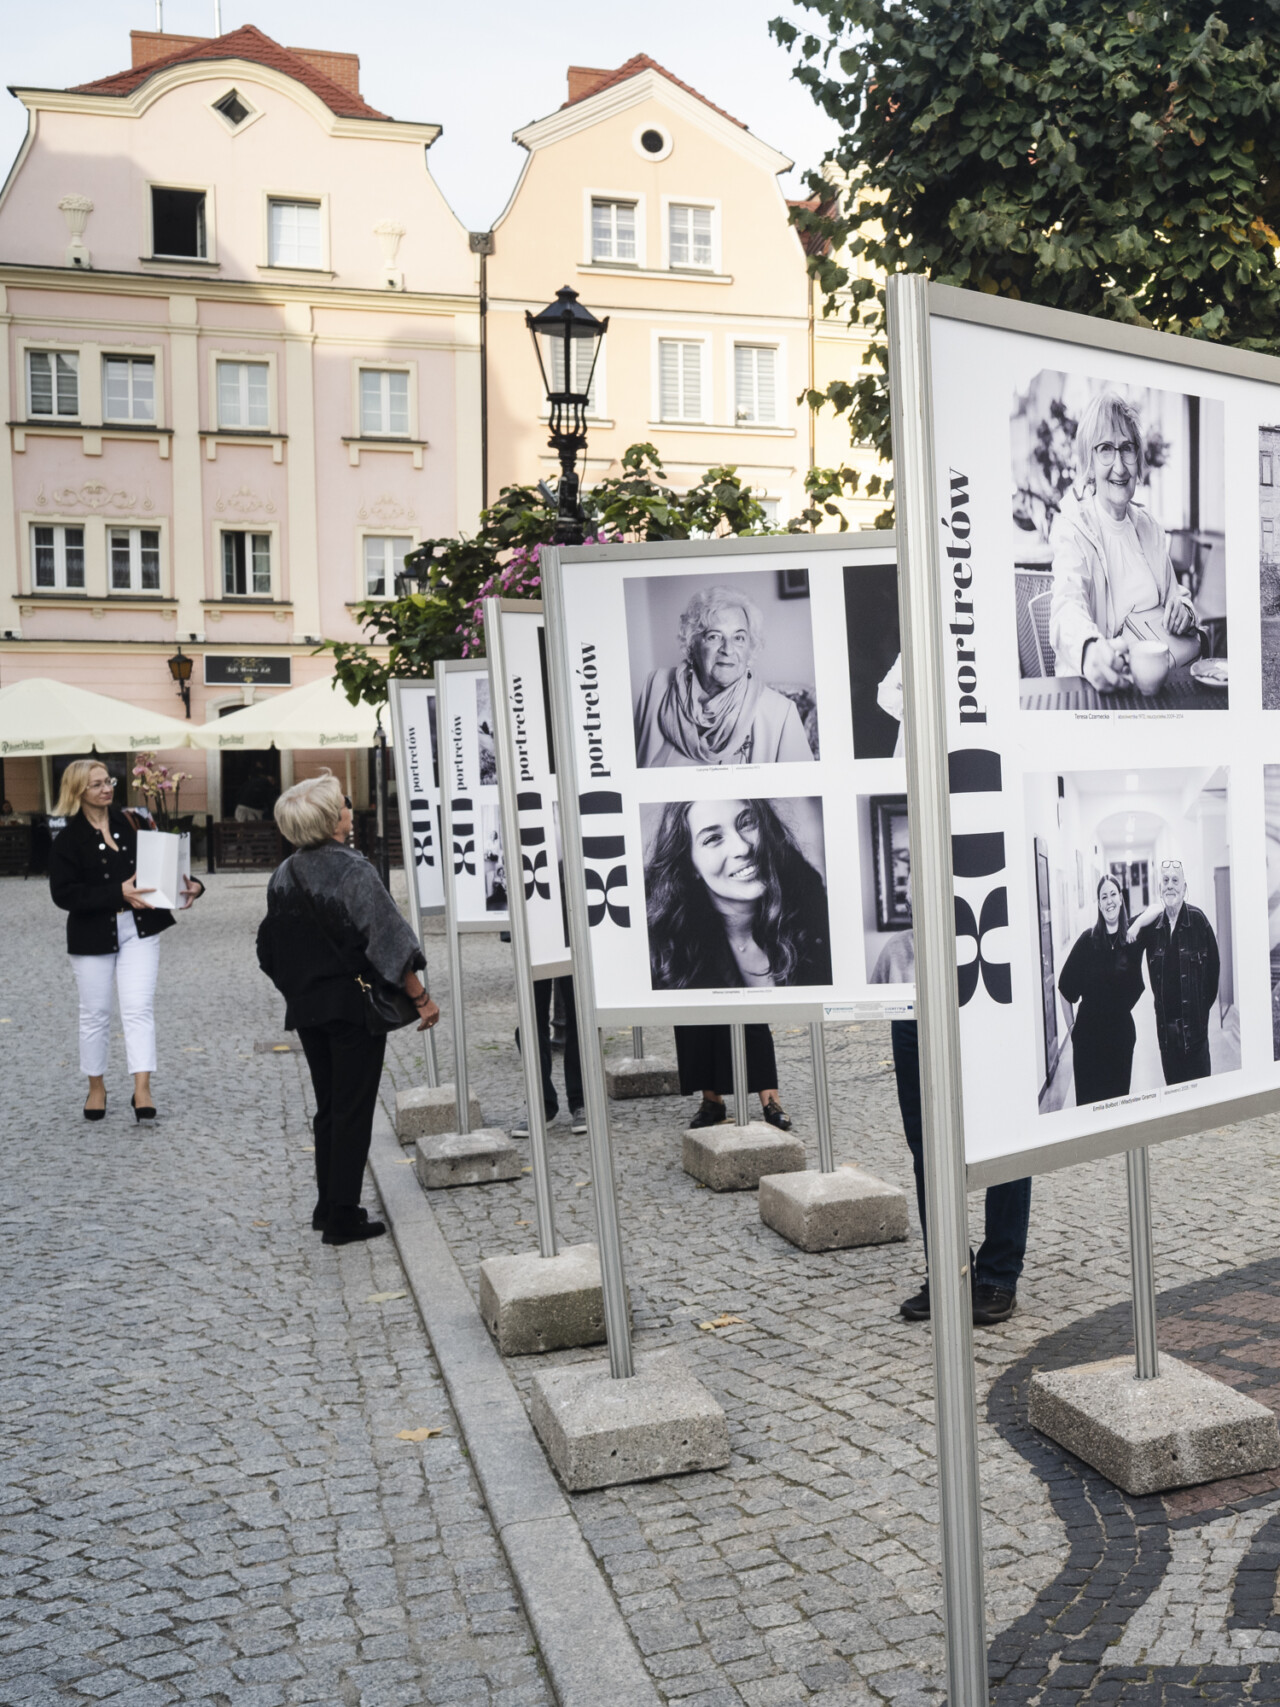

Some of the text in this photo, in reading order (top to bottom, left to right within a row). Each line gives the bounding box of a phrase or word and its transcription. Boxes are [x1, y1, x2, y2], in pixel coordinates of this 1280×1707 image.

[941, 466, 988, 726] portretów
[406, 726, 423, 792] portretów
[451, 715, 468, 791] portretów
[509, 675, 534, 781] portretów
[576, 642, 611, 778] portretów
